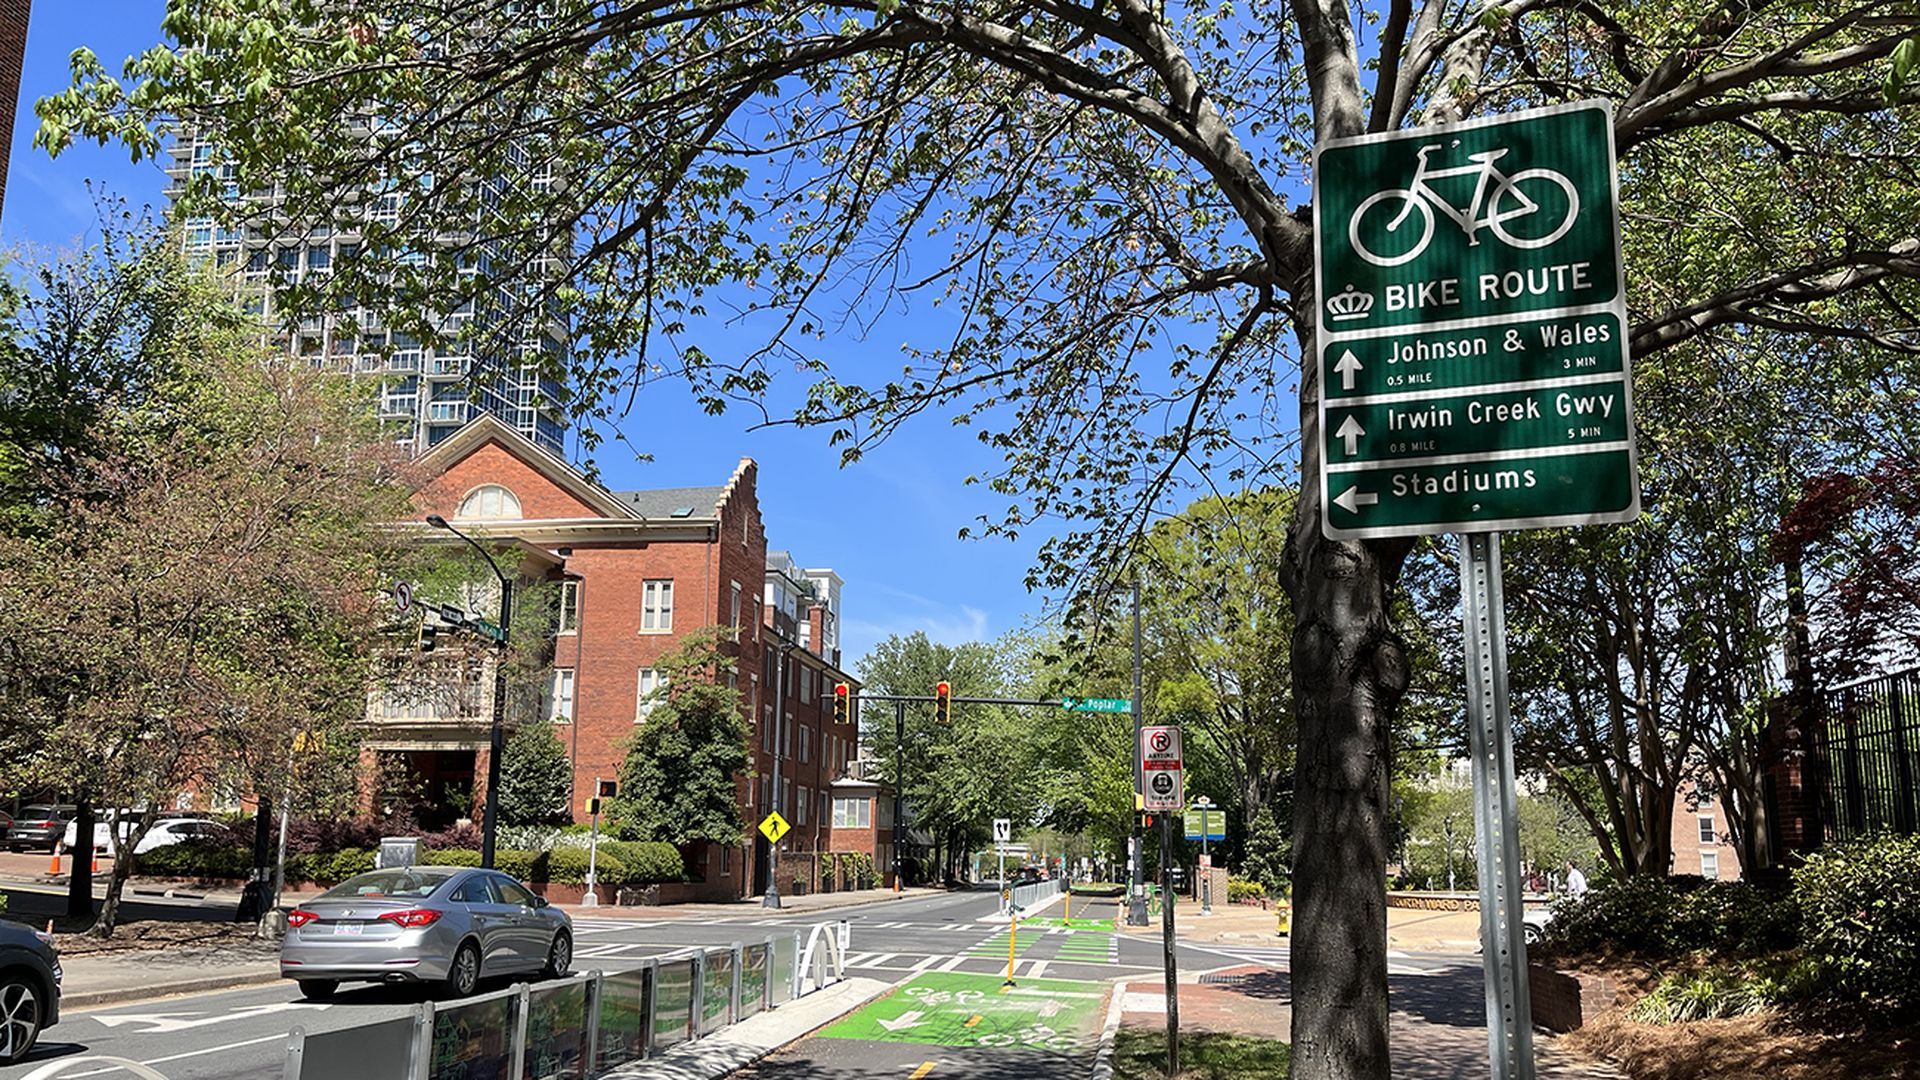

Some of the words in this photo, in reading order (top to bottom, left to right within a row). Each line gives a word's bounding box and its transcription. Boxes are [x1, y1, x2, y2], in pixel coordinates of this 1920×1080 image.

[1385, 279, 1460, 312] BIKE
[1479, 262, 1593, 301] ROUTE
[1387, 336, 1488, 364] Johnson
[1503, 329, 1526, 352] &
[1540, 322, 1611, 348] Wales
[1563, 358, 1571, 369] 3
[1576, 356, 1597, 368] MIN
[1387, 375, 1404, 386] 0.5
[1408, 372, 1432, 384] MILE
[1388, 405, 1453, 431] Irwin
[1467, 396, 1542, 425] Creek
[1556, 392, 1614, 418] Gwy
[1567, 428, 1576, 439] 5
[1580, 426, 1602, 437] MIN
[1390, 442, 1407, 453] 0.8
[1411, 440, 1436, 451] MILE
[1392, 468, 1537, 497] Stadiums
[1087, 698, 1116, 711] Poplar
[1464, 900, 1480, 912] PA
